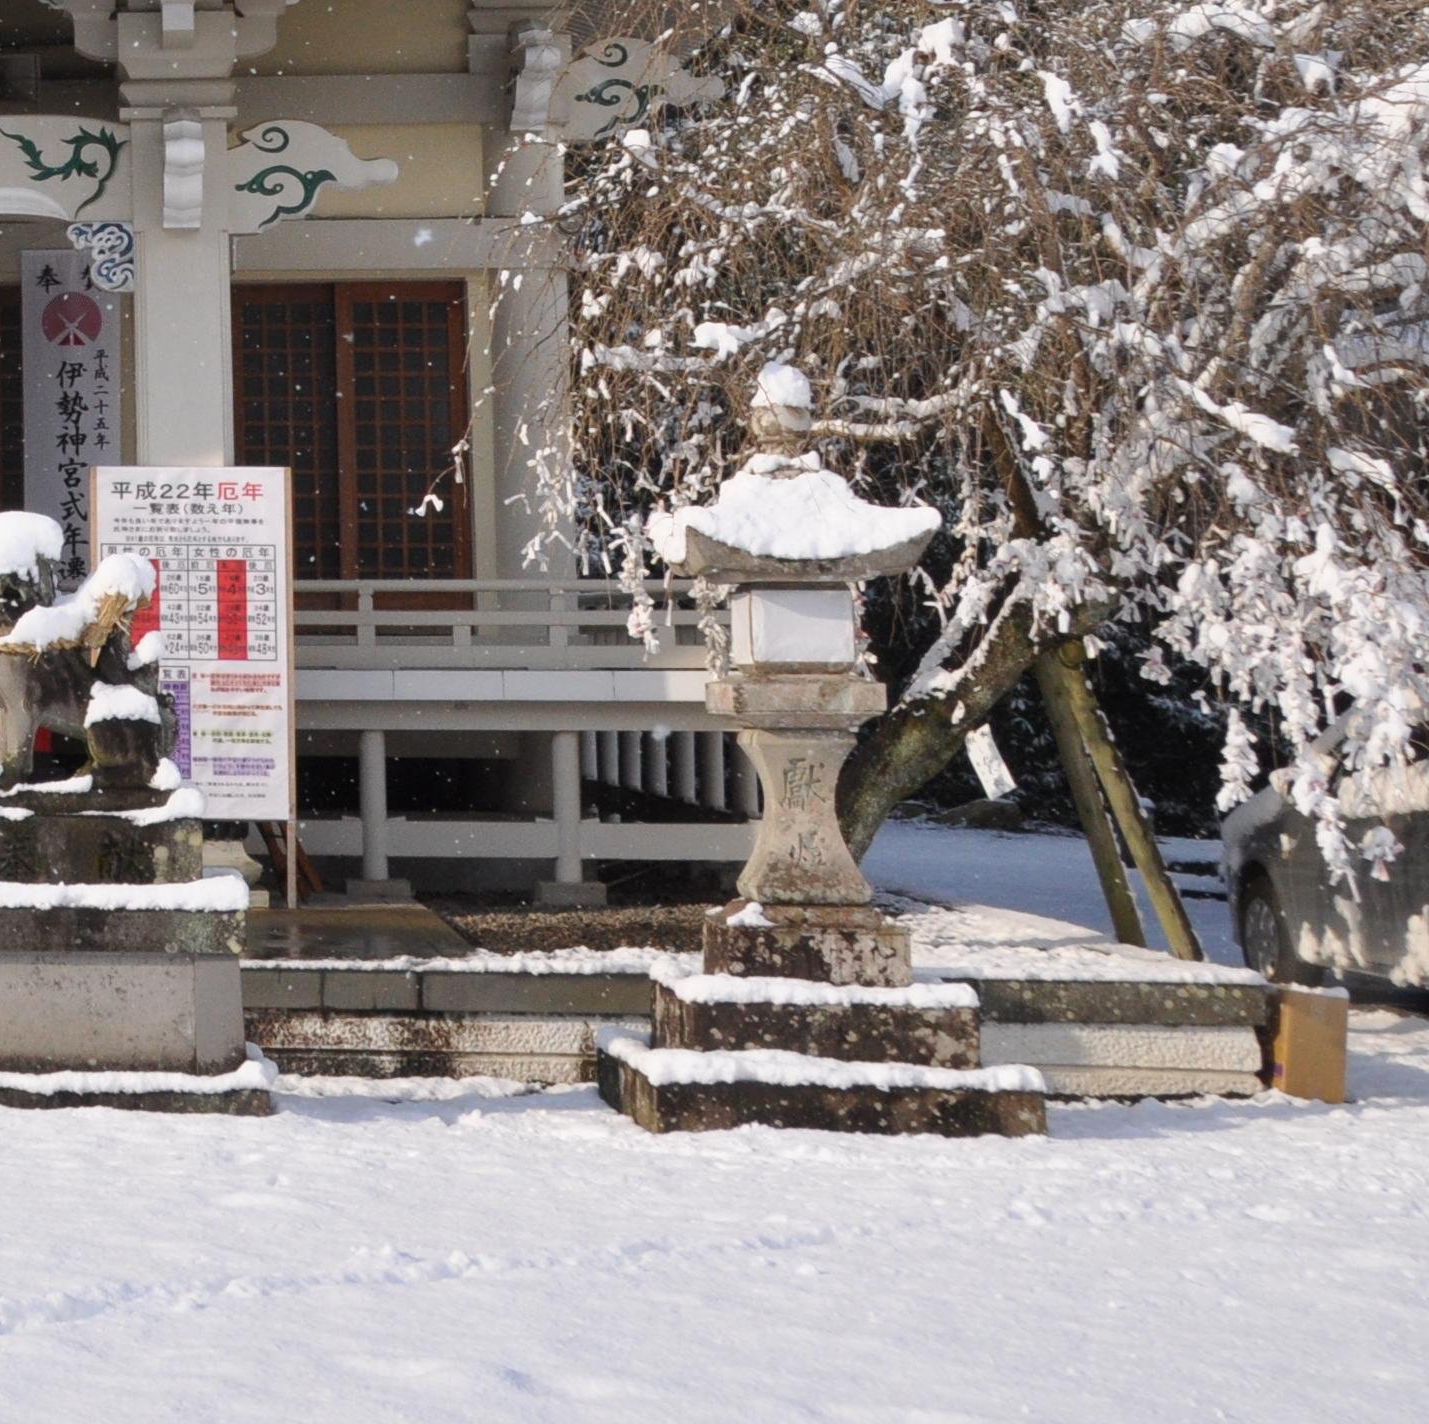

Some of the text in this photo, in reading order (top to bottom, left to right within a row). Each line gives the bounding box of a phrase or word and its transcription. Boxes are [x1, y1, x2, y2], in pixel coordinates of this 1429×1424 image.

[93, 349, 110, 451] 平成二十五年
[111, 481, 263, 501] 平成22年厄年
[193, 546, 270, 558] 女性の厄年
